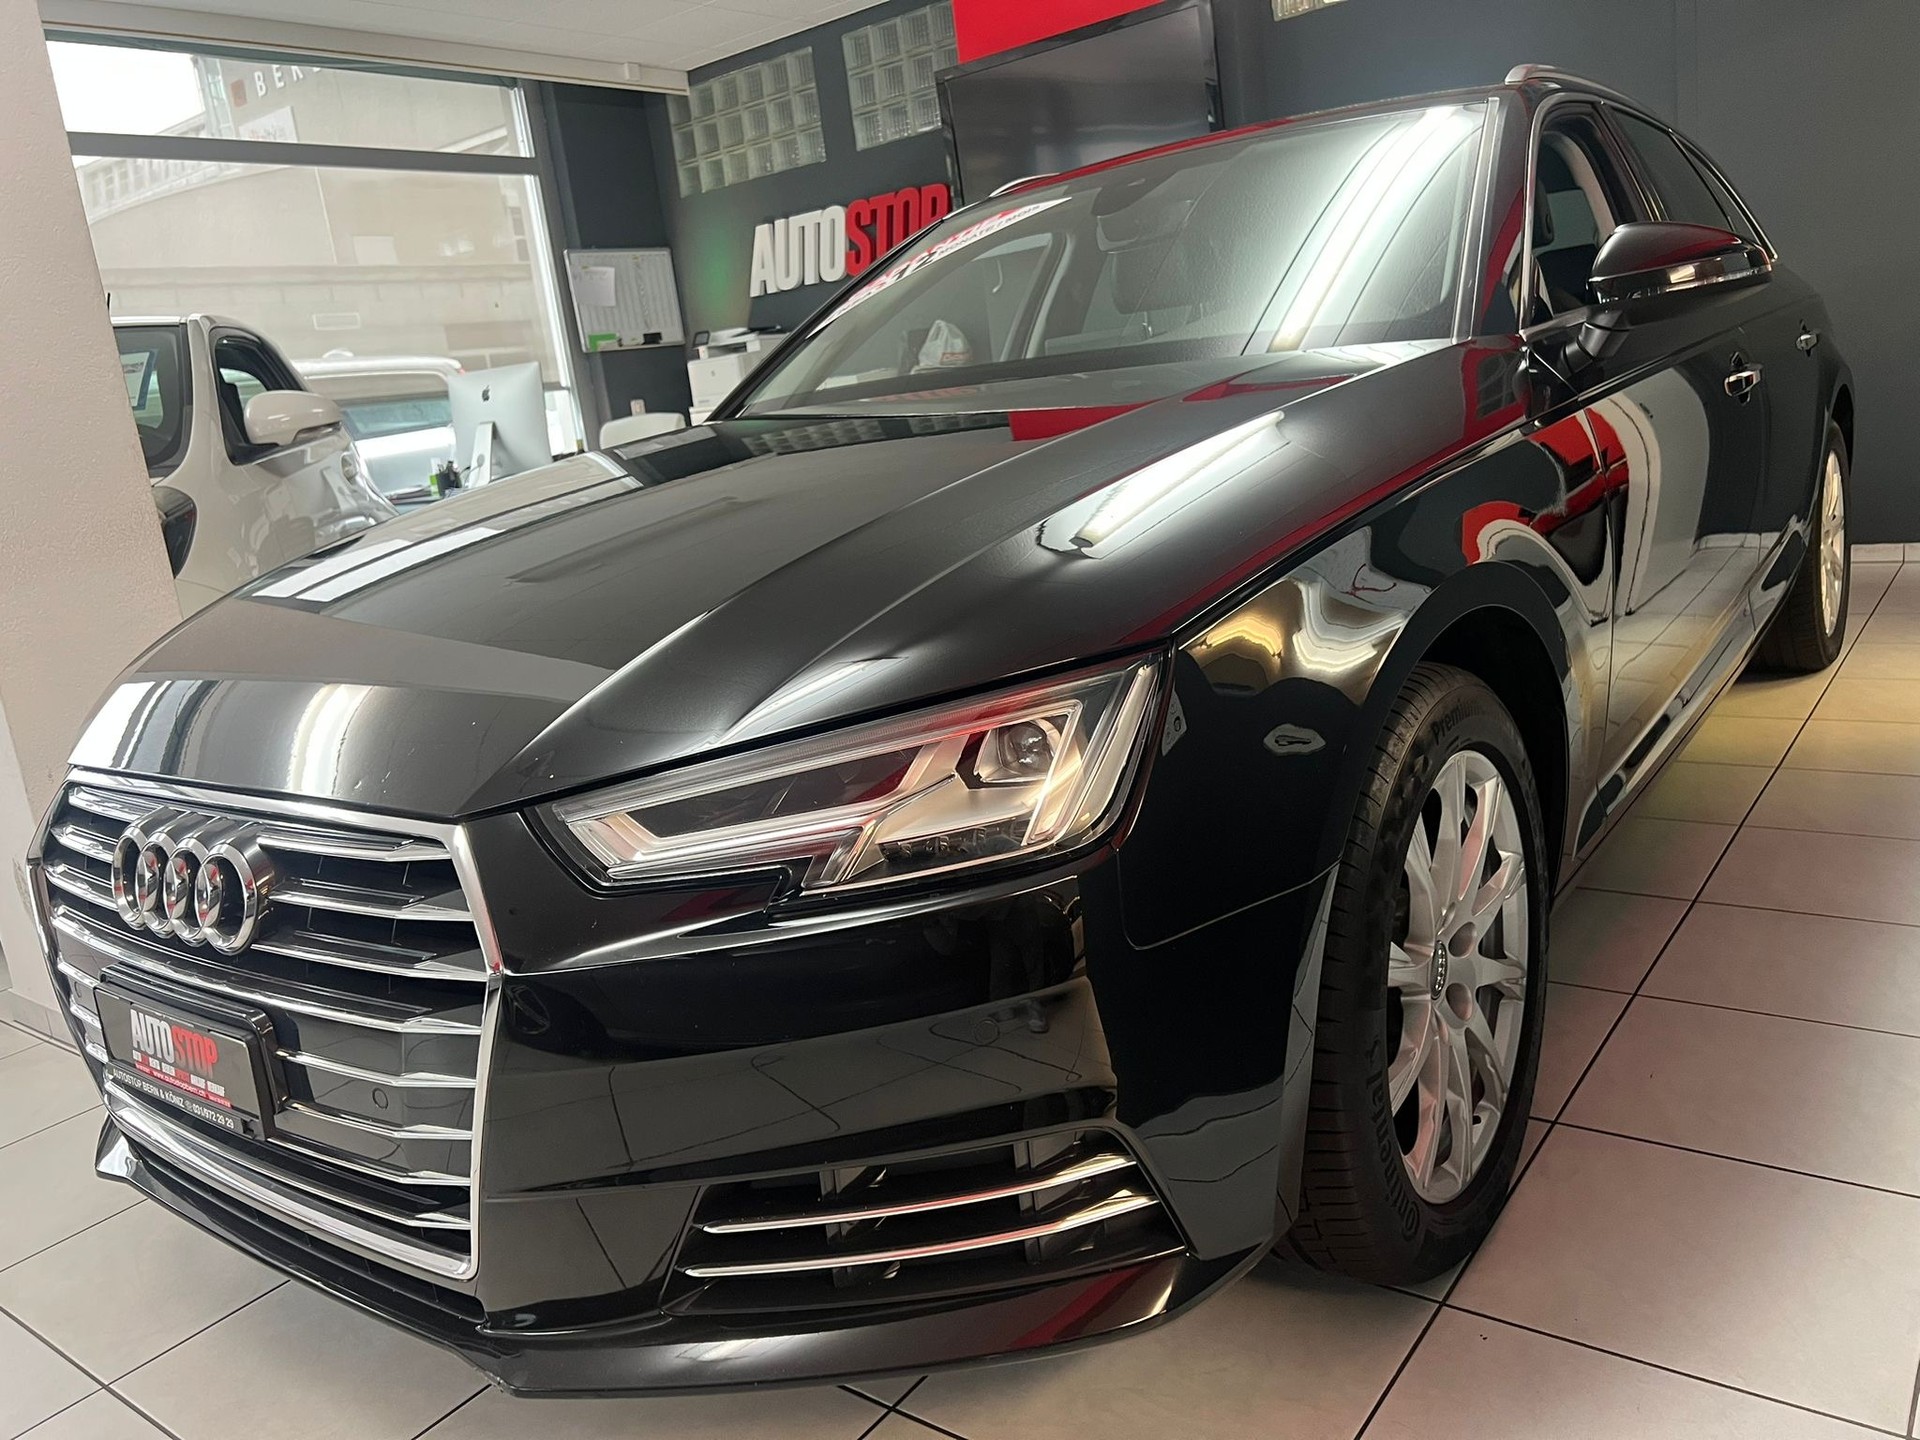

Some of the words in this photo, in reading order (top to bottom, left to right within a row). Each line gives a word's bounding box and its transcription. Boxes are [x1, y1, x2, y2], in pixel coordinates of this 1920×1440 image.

[113, 1068, 142, 1088] AUTOSTOP
[142, 1081, 160, 1097] BERN
[216, 1115, 225, 1125] 29
[225, 1118, 235, 1129] 29
